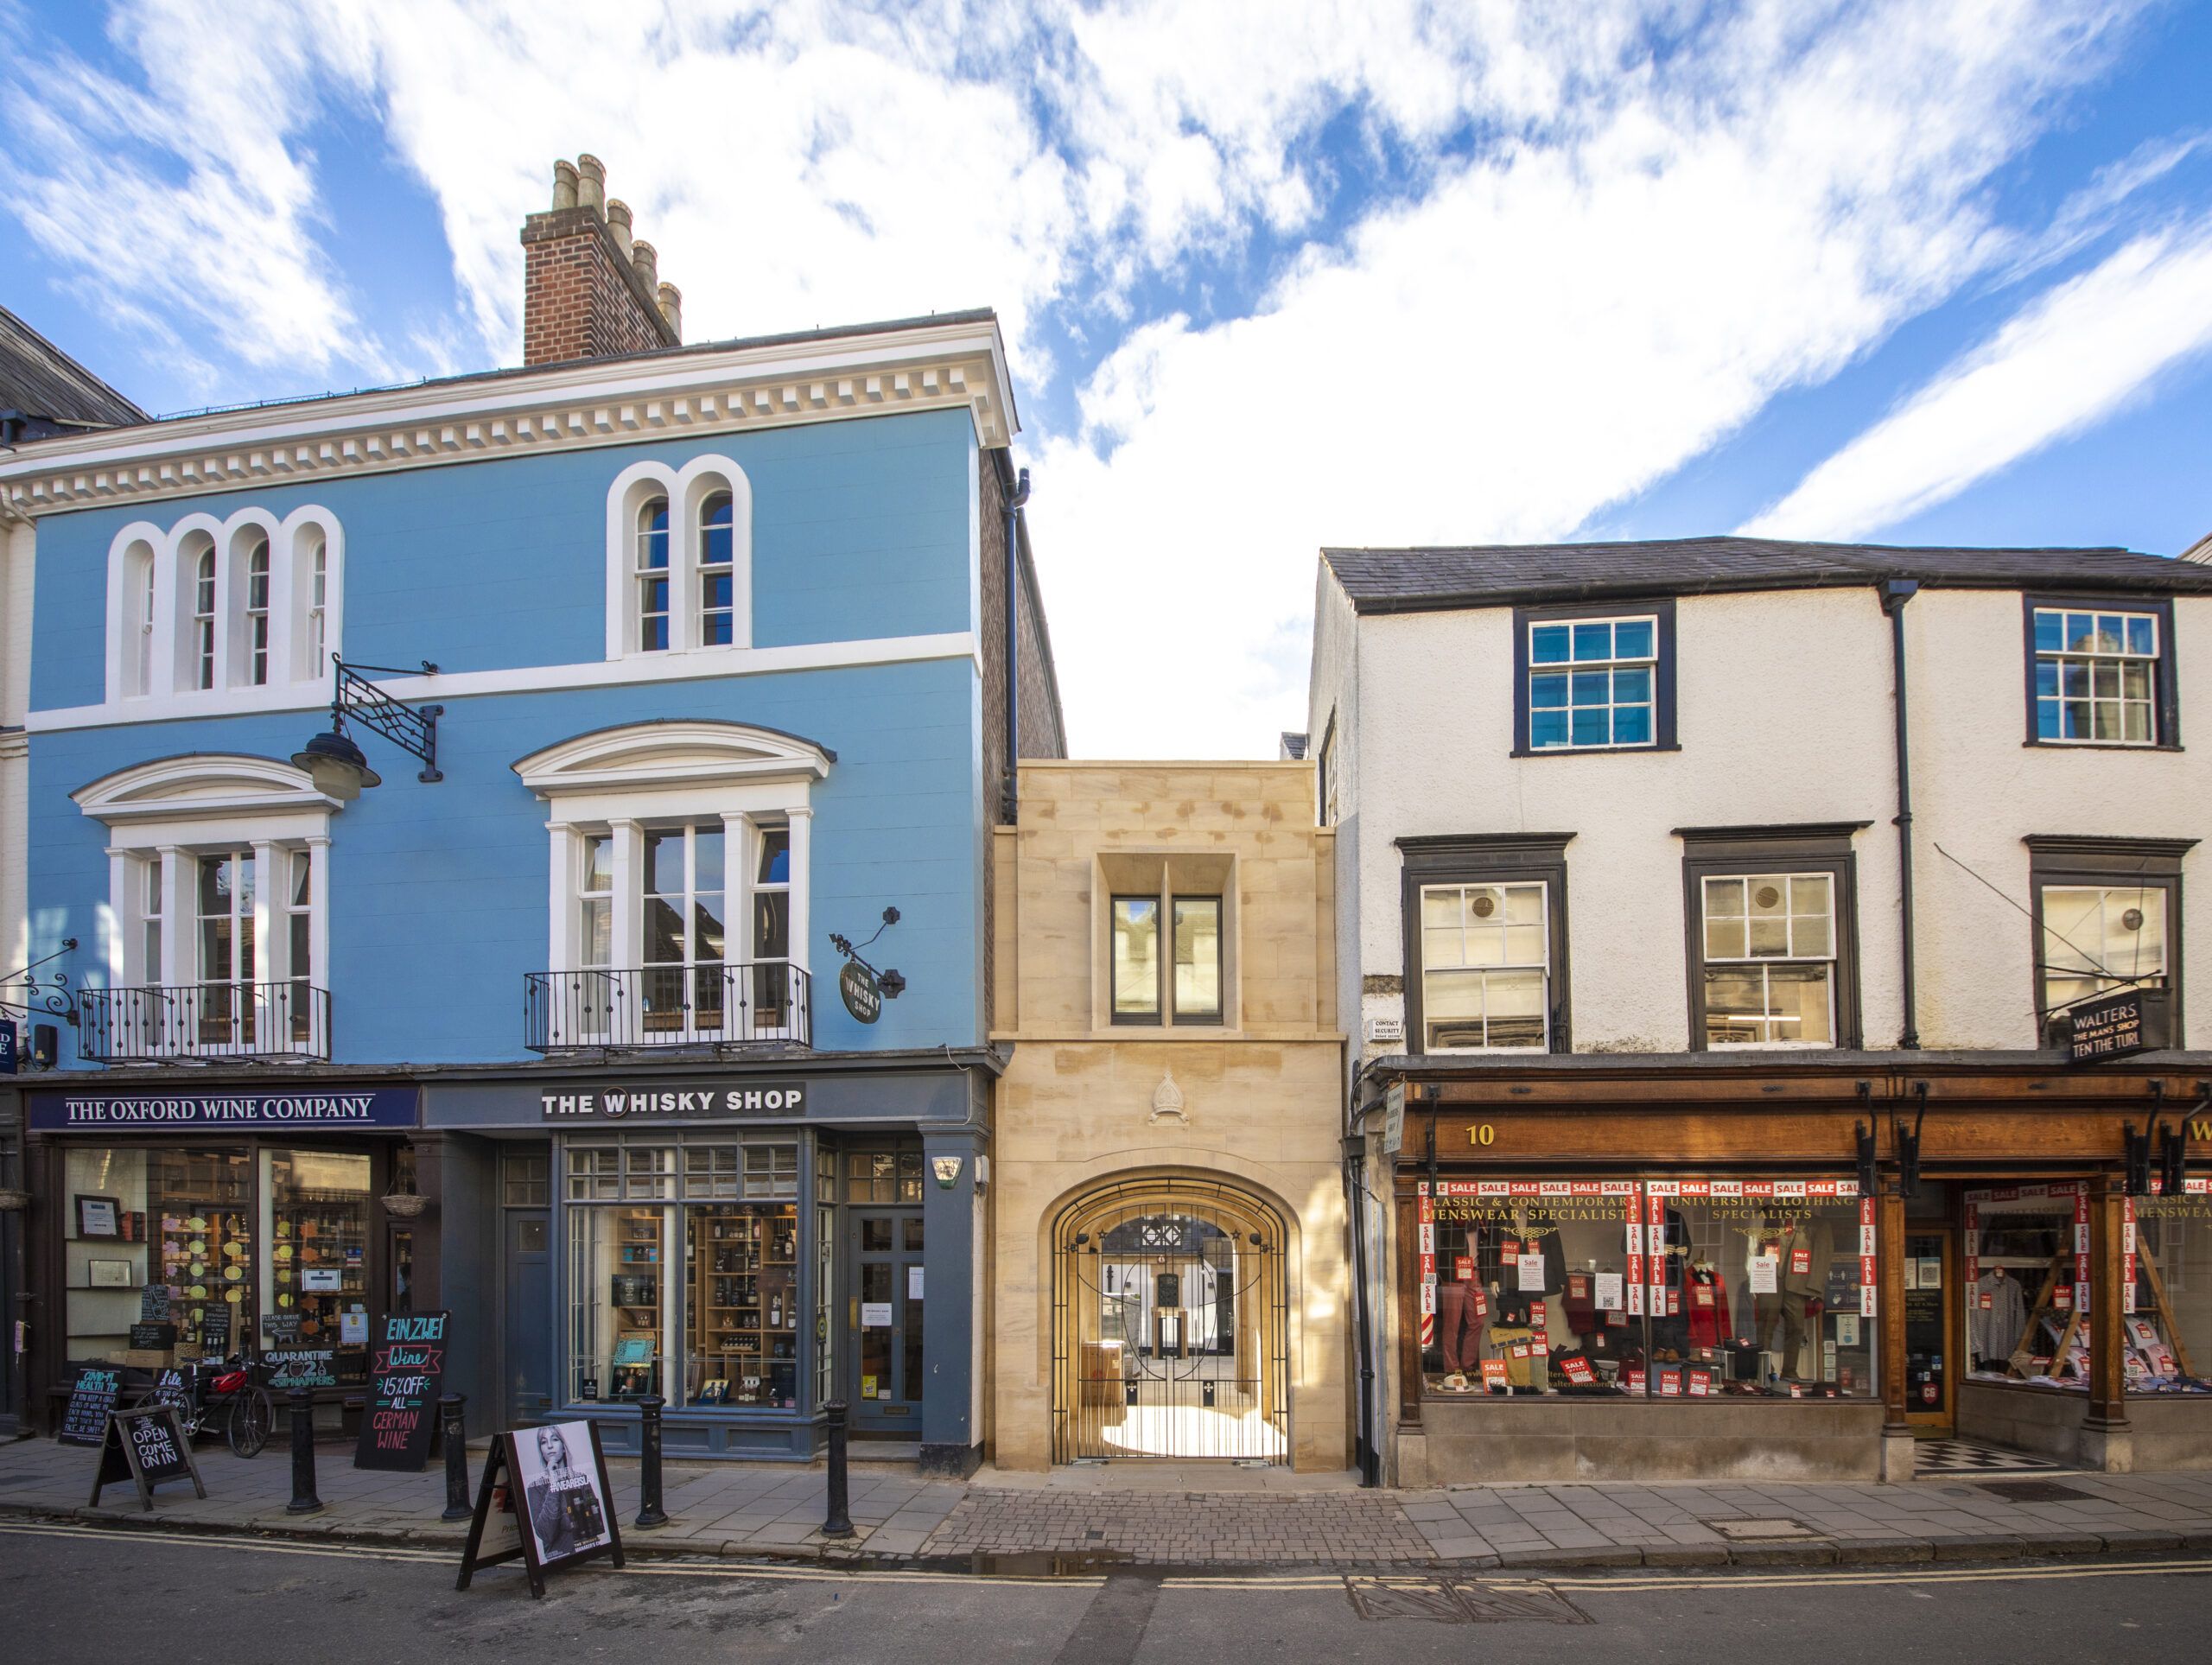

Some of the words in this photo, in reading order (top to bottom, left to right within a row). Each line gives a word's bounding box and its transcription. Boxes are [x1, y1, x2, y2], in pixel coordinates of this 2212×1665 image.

[857, 973, 868, 988] THE
[845, 976, 880, 1011] WHISKY
[855, 1001, 871, 1017] SHOP
[2073, 1032, 2088, 1042] THE
[2117, 1020, 2139, 1032] SHOP
[2073, 1042, 2093, 1058] TEN
[2094, 1037, 2113, 1053] THE
[2115, 1032, 2140, 1049] TURL
[66, 1102, 106, 1121] THE
[111, 1100, 196, 1121] OXFORD
[200, 1099, 257, 1119] WINE
[263, 1097, 372, 1119] COMPANY
[542, 1095, 594, 1114] THE
[604, 1091, 715, 1114] WHISKY
[726, 1090, 802, 1109] SHOP
[1465, 1125, 1495, 1146] 10
[1450, 1184, 1477, 1192] SALE
[1480, 1184, 1506, 1192] SALE
[1511, 1184, 1537, 1192] SALE
[1604, 1183, 1630, 1192] SALE
[1650, 1184, 1676, 1192] SALE
[1681, 1184, 1708, 1193] SALE
[1713, 1184, 1739, 1193] SALE
[1745, 1185, 1771, 1193] SALE
[1777, 1185, 1803, 1193] SALE
[1808, 1184, 1834, 1193] SALE
[1840, 1184, 1859, 1192] SAL
[1993, 1190, 2018, 1199] SALE
[2049, 1185, 2076, 1195] SALE
[1491, 1197, 1502, 1207] &
[1670, 1197, 1764, 1206] UNIVERSITY
[1771, 1197, 1854, 1206] CLOTHING
[2133, 1194, 2191, 1204] CLASSIC
[2197, 1194, 2207, 1204] &
[1423, 1210, 1520, 1220] MENSWEAR
[1713, 1210, 1812, 1219] SPECIALISTS
[264, 1350, 334, 1363] QUARANTINE
[389, 1347, 429, 1366] Wine
[1565, 1361, 1585, 1369] SALE
[76, 1380, 104, 1391] HEALTH
[106, 1382, 118, 1393] TIP
[1923, 1388, 1936, 1398] CG
[391, 1396, 407, 1409] ALL
[372, 1410, 420, 1430] GERMAN
[133, 1427, 168, 1444] OPEN
[377, 1431, 411, 1450] WINE
[138, 1439, 174, 1457] COME
[142, 1455, 161, 1469] ON
[160, 1451, 178, 1465] IN
